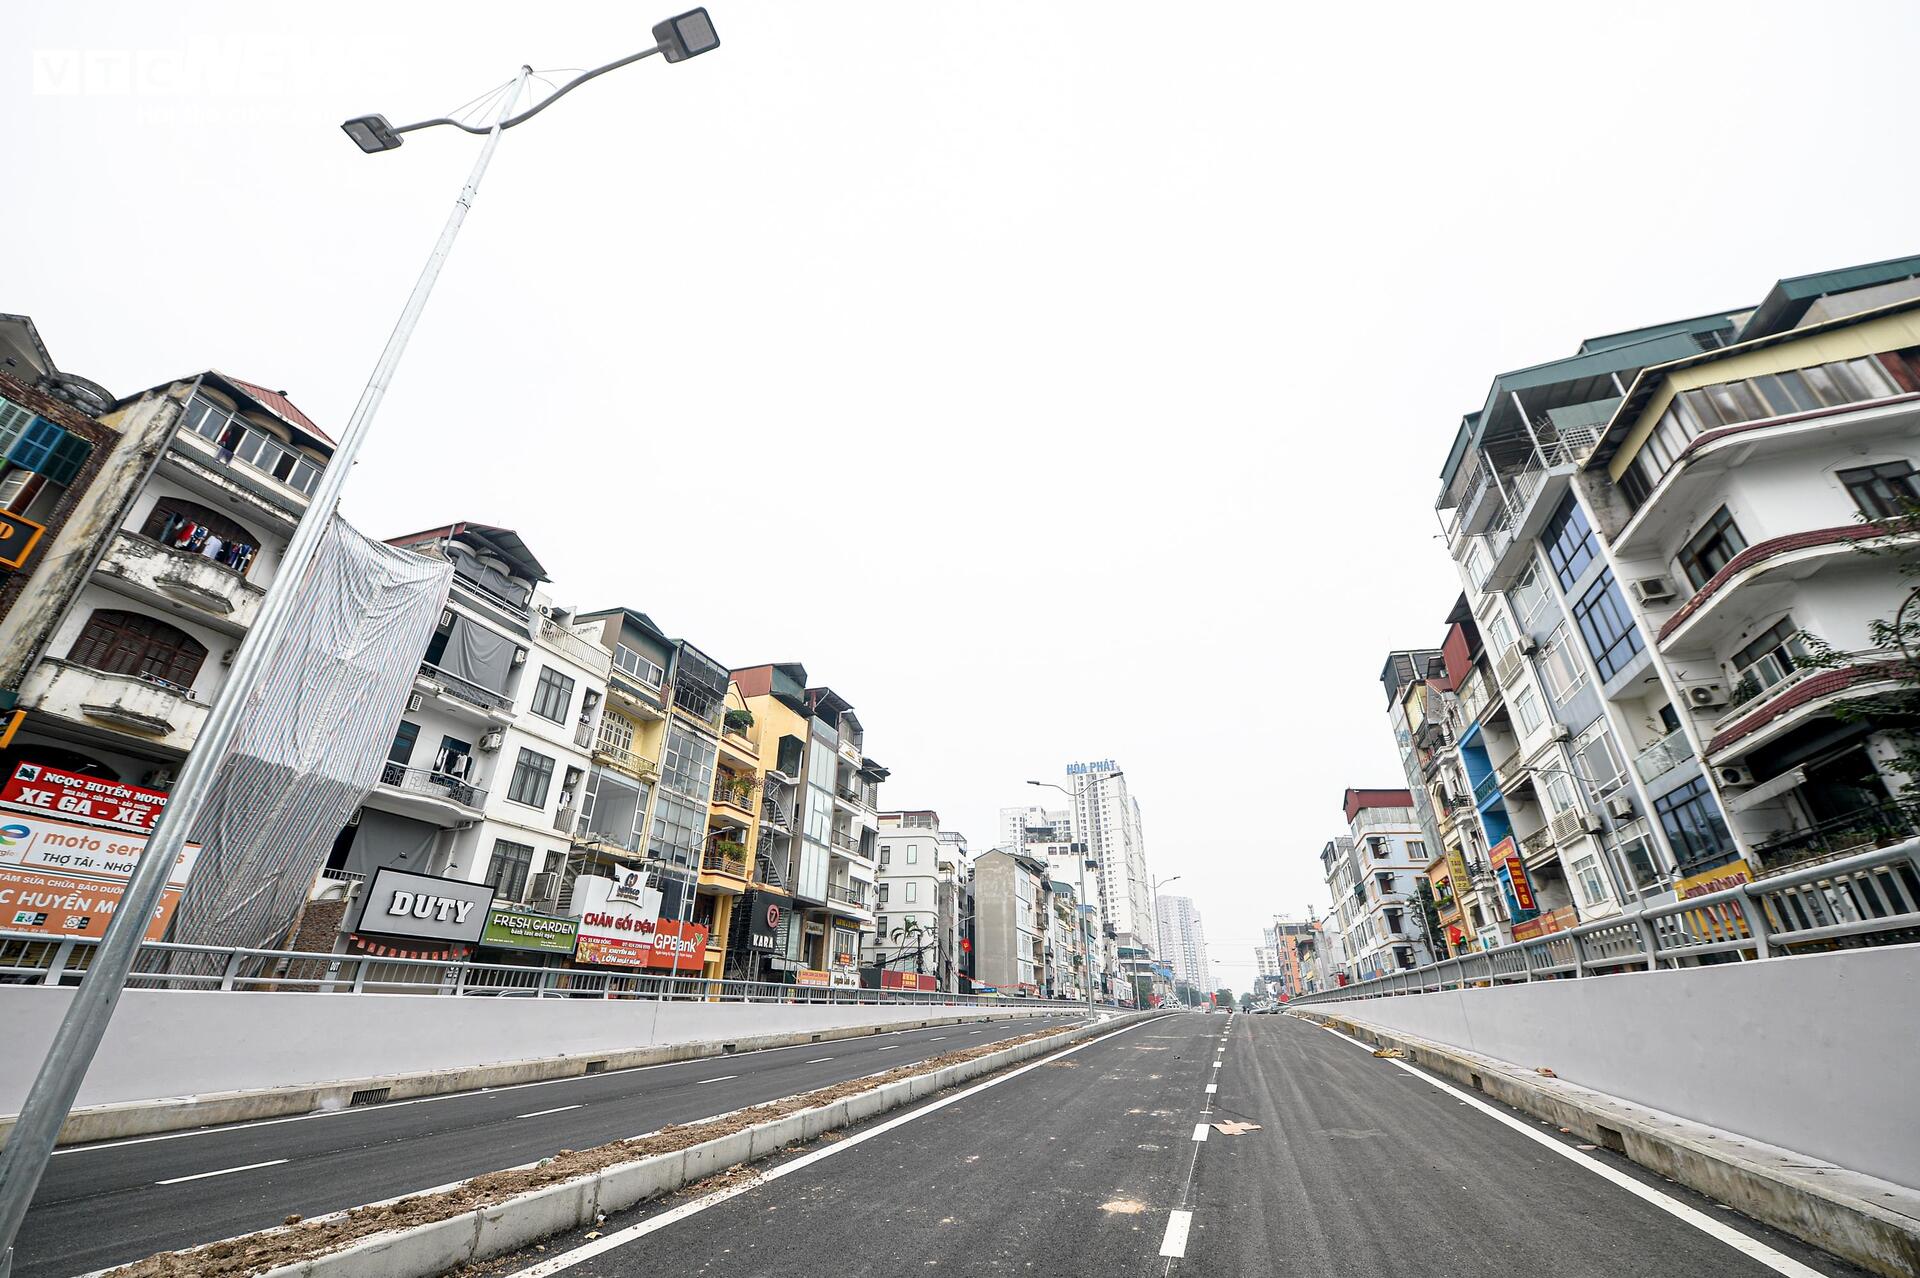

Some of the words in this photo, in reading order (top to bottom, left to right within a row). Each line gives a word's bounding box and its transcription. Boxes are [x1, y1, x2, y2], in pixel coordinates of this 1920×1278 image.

[1090, 758, 1116, 772] PHÁT
[44, 772, 84, 788] NGỌC
[85, 784, 134, 798] HUYỀN
[15, 786, 56, 808] XE
[57, 796, 92, 816] GA
[112, 806, 148, 826] XE
[44, 832, 100, 852] moto
[42, 852, 70, 866] THỢ
[17, 890, 92, 912] HUYỀN
[388, 890, 475, 924] DUTY
[1521, 895, 1530, 905] 6
[493, 914, 531, 929] FRESH
[532, 920, 576, 935] GARDEN
[584, 912, 614, 928] CHĂN
[654, 933, 696, 952] GPBank
[753, 934, 774, 948] KARA
